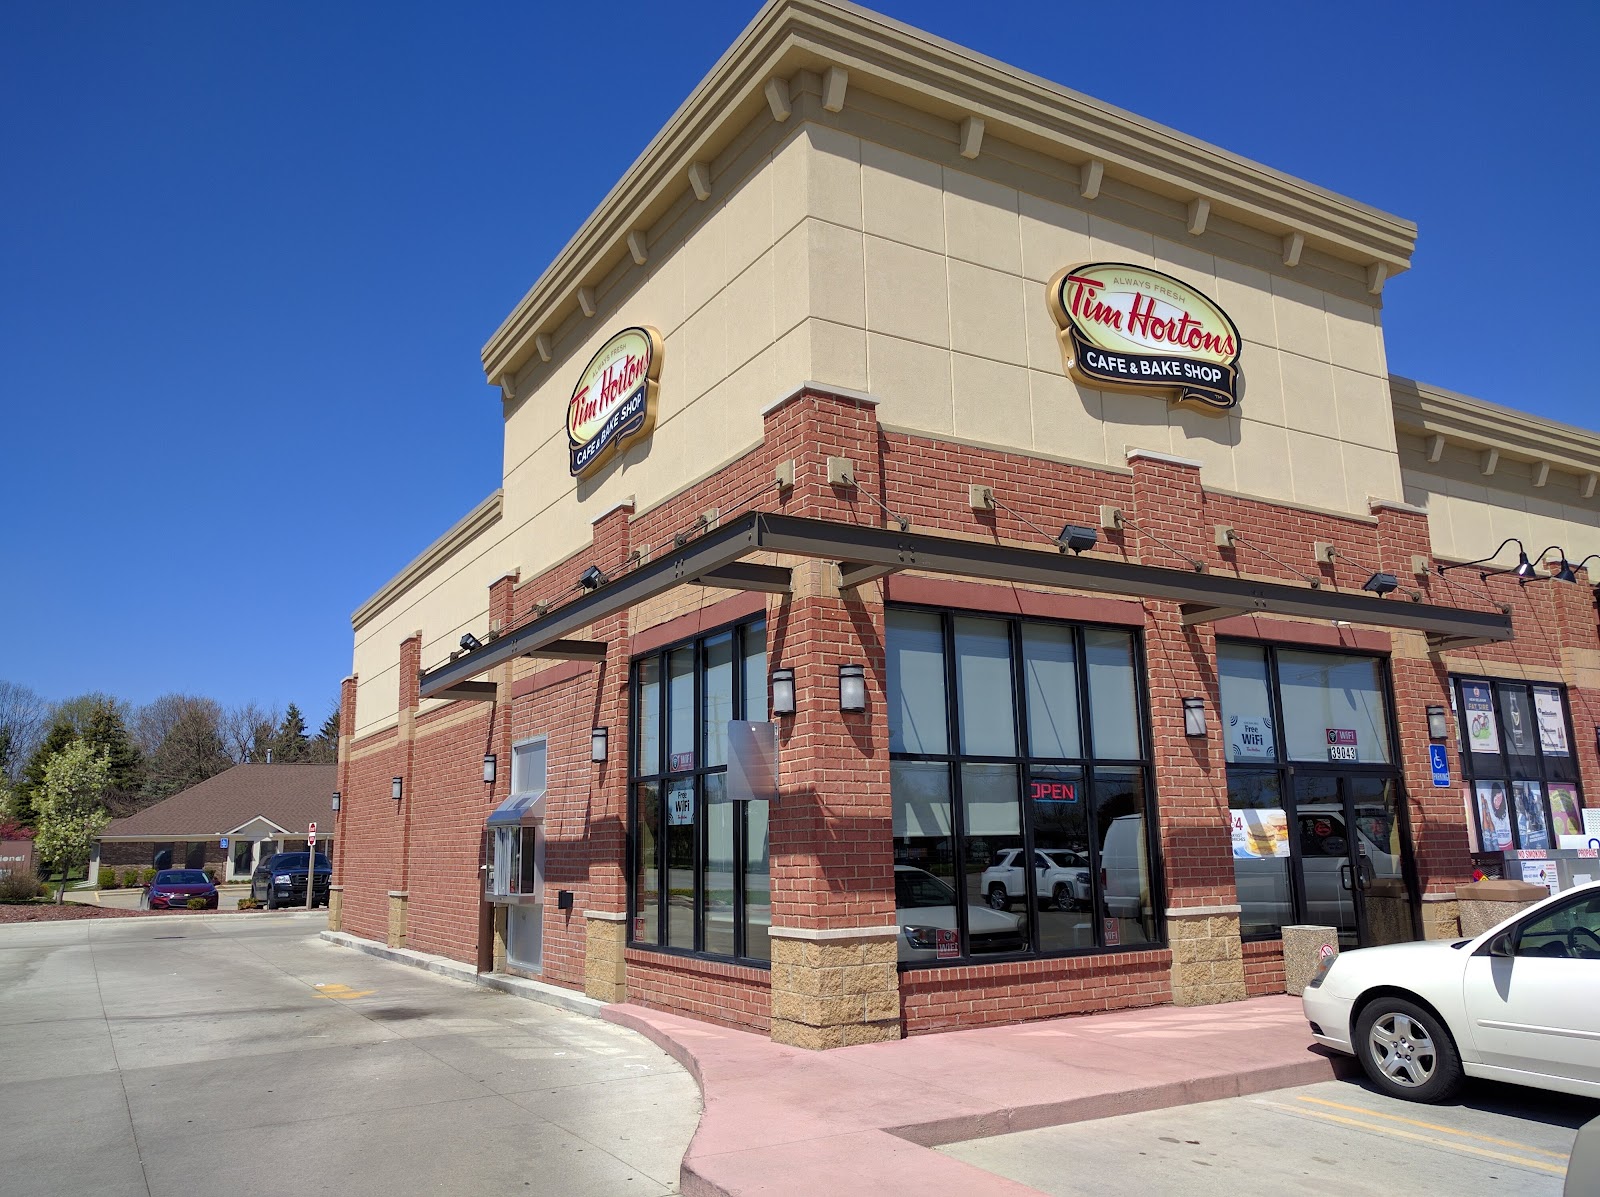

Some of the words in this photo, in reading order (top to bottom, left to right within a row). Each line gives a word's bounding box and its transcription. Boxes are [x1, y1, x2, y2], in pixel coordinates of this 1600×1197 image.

[1113, 276, 1151, 290] ALWAYS
[1154, 284, 1186, 303] FRESH
[1067, 275, 1122, 330] Tim
[1127, 291, 1235, 356] Hortons
[592, 355, 611, 379] ALWAYS
[610, 343, 627, 358] FRESH
[1086, 351, 1128, 374] CAFE
[1130, 363, 1138, 374] &
[1140, 359, 1182, 376] BAKE
[1183, 363, 1222, 383] SHOP
[571, 385, 598, 432] Tim
[599, 348, 650, 414] Hortons
[576, 442, 597, 465] CAFE
[595, 438, 601, 450] &
[600, 411, 620, 445] BAKE
[620, 392, 643, 421] SHOP
[1244, 725, 1259, 733] Free
[1241, 733, 1263, 745] WiFi
[1331, 746, 1356, 759] 39043
[677, 791, 688, 799] Free
[675, 799, 690, 812] WiFi
[1517, 850, 1525, 858] NO
[1525, 850, 1547, 859] SMOKING
[1578, 849, 1597, 858] PROPANE
